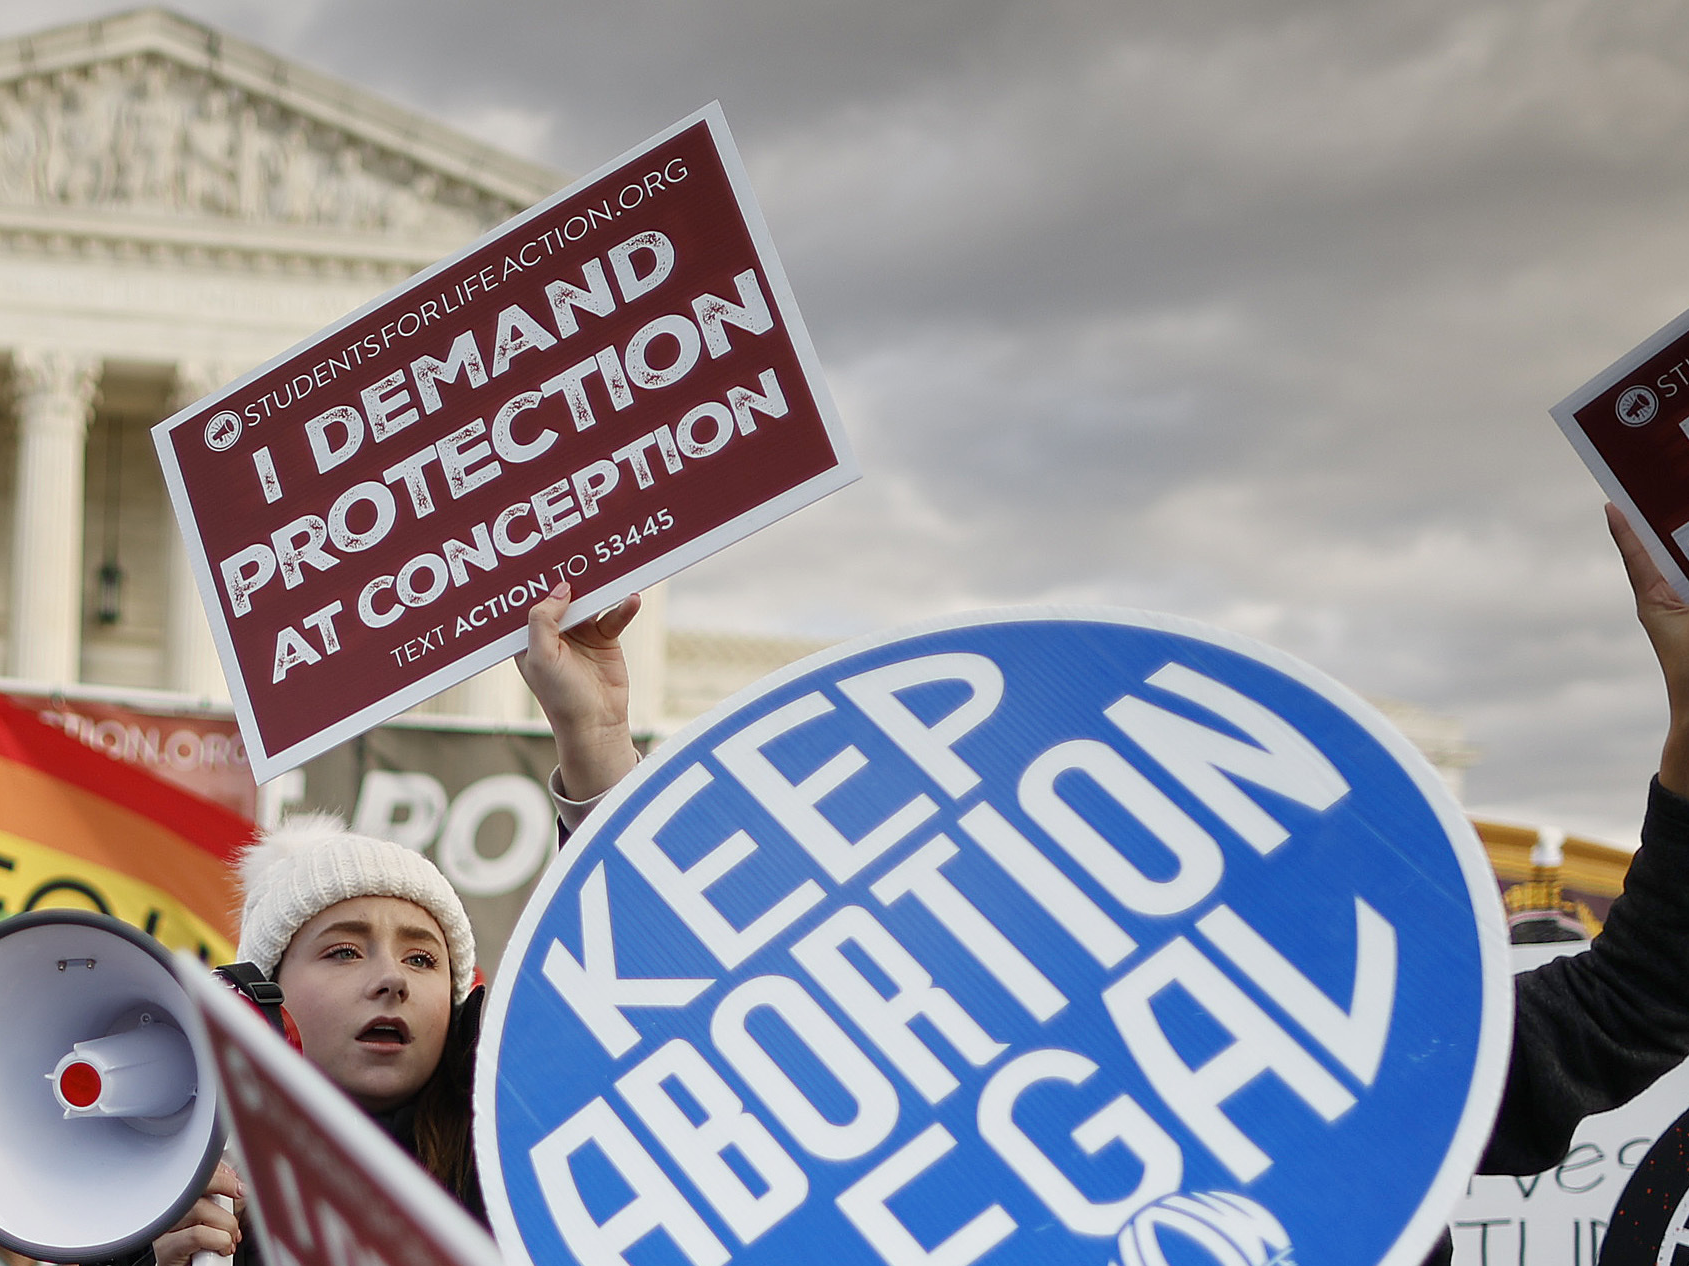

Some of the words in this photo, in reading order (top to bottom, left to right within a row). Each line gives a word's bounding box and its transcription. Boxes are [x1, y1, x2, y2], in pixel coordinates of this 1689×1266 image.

[245, 158, 689, 427] STUDENTSFORLIFEACTION.ORG
[252, 446, 283, 504] I
[304, 229, 676, 474] DEMAND
[220, 269, 774, 617] PROTECTION
[272, 600, 342, 684] AT
[357, 368, 788, 630] CONCEPTION
[390, 625, 446, 668] TEXT
[454, 574, 549, 638] ACTION
[553, 552, 588, 587] TO
[593, 509, 674, 565] 53445
[541, 652, 1005, 1059] KEEP
